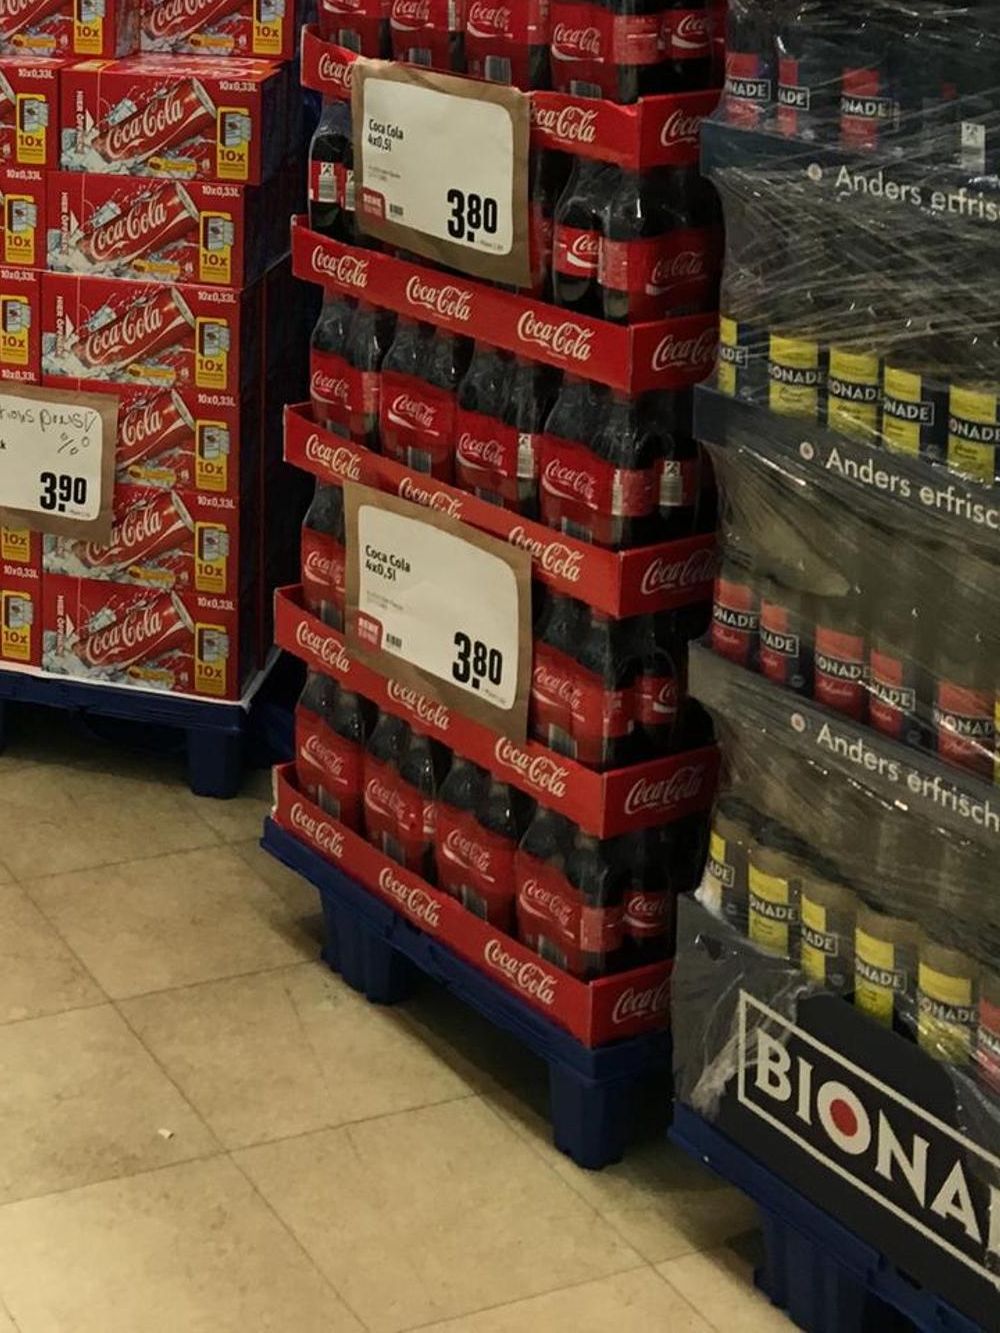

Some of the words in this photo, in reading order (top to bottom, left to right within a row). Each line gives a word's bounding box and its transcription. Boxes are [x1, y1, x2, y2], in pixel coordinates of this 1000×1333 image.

[76, 26, 99, 36] 10x
[256, 27, 278, 37] 10x
[730, 83, 768, 98] NADE
[369, 119, 385, 133] Coca
[387, 124, 403, 140] Cola
[532, 106, 597, 143] oca-Cola
[19, 135, 43, 146] 10x
[220, 150, 245, 162] 10x
[835, 165, 920, 206] Anders
[931, 190, 1000, 220] erfris
[8, 235, 31, 247] 10x
[202, 254, 227, 266] 10x
[2, 336, 25, 348] 10x
[198, 360, 223, 373] 10x
[884, 398, 929, 421] NADE
[198, 463, 223, 475] 10x
[825, 448, 911, 497] Anders
[920, 485, 1000, 529] erfrisc
[3, 533, 27, 545] 10x
[366, 545, 387, 562] Coca
[390, 555, 410, 572] Cola
[198, 564, 222, 577] 10x
[4, 631, 28, 644] 10x
[761, 632, 794, 652] NADE
[198, 666, 222, 679] 10x
[818, 723, 900, 781] Anders
[907, 772, 999, 832] erfrisch
